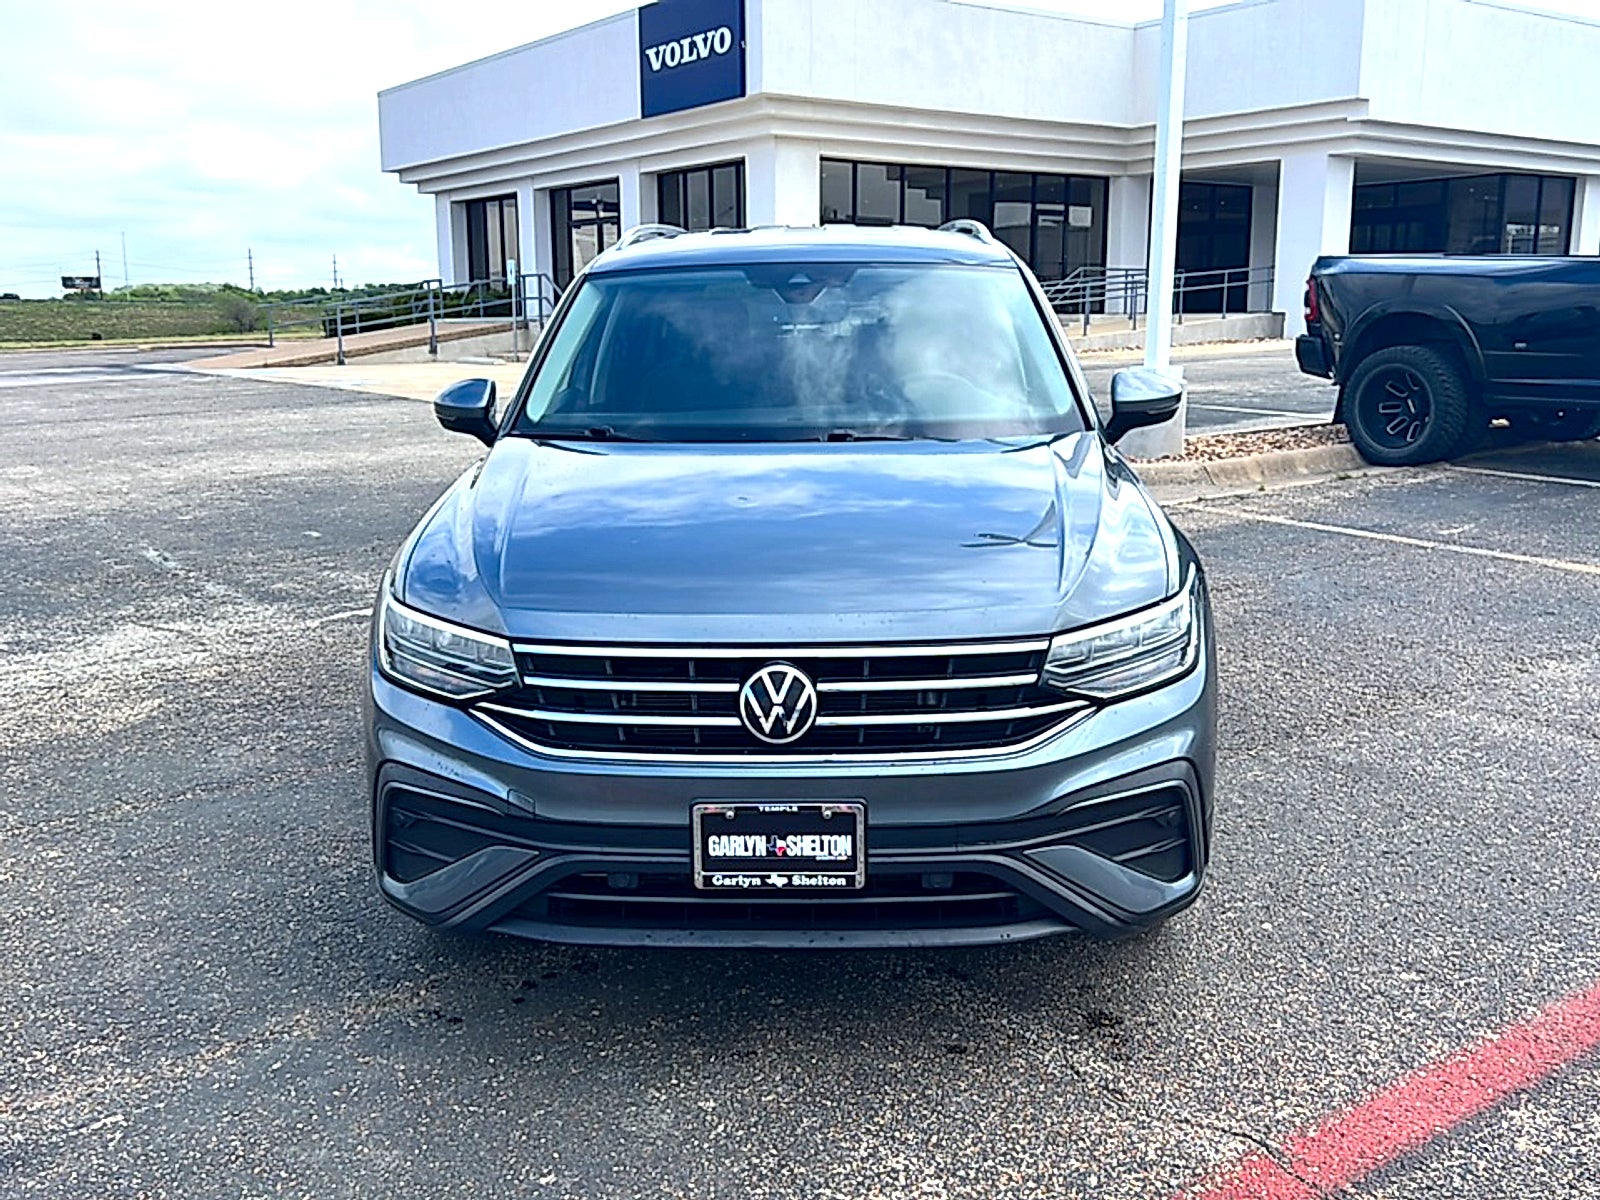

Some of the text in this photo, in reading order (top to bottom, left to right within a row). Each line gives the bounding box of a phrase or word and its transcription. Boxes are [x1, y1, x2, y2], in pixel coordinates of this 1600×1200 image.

[645, 26, 732, 71] VOLVO
[758, 804, 799, 812] TEMPLE
[708, 835, 852, 857] GARLYN SHELTON
[711, 875, 847, 888] Garlyn Shelton
